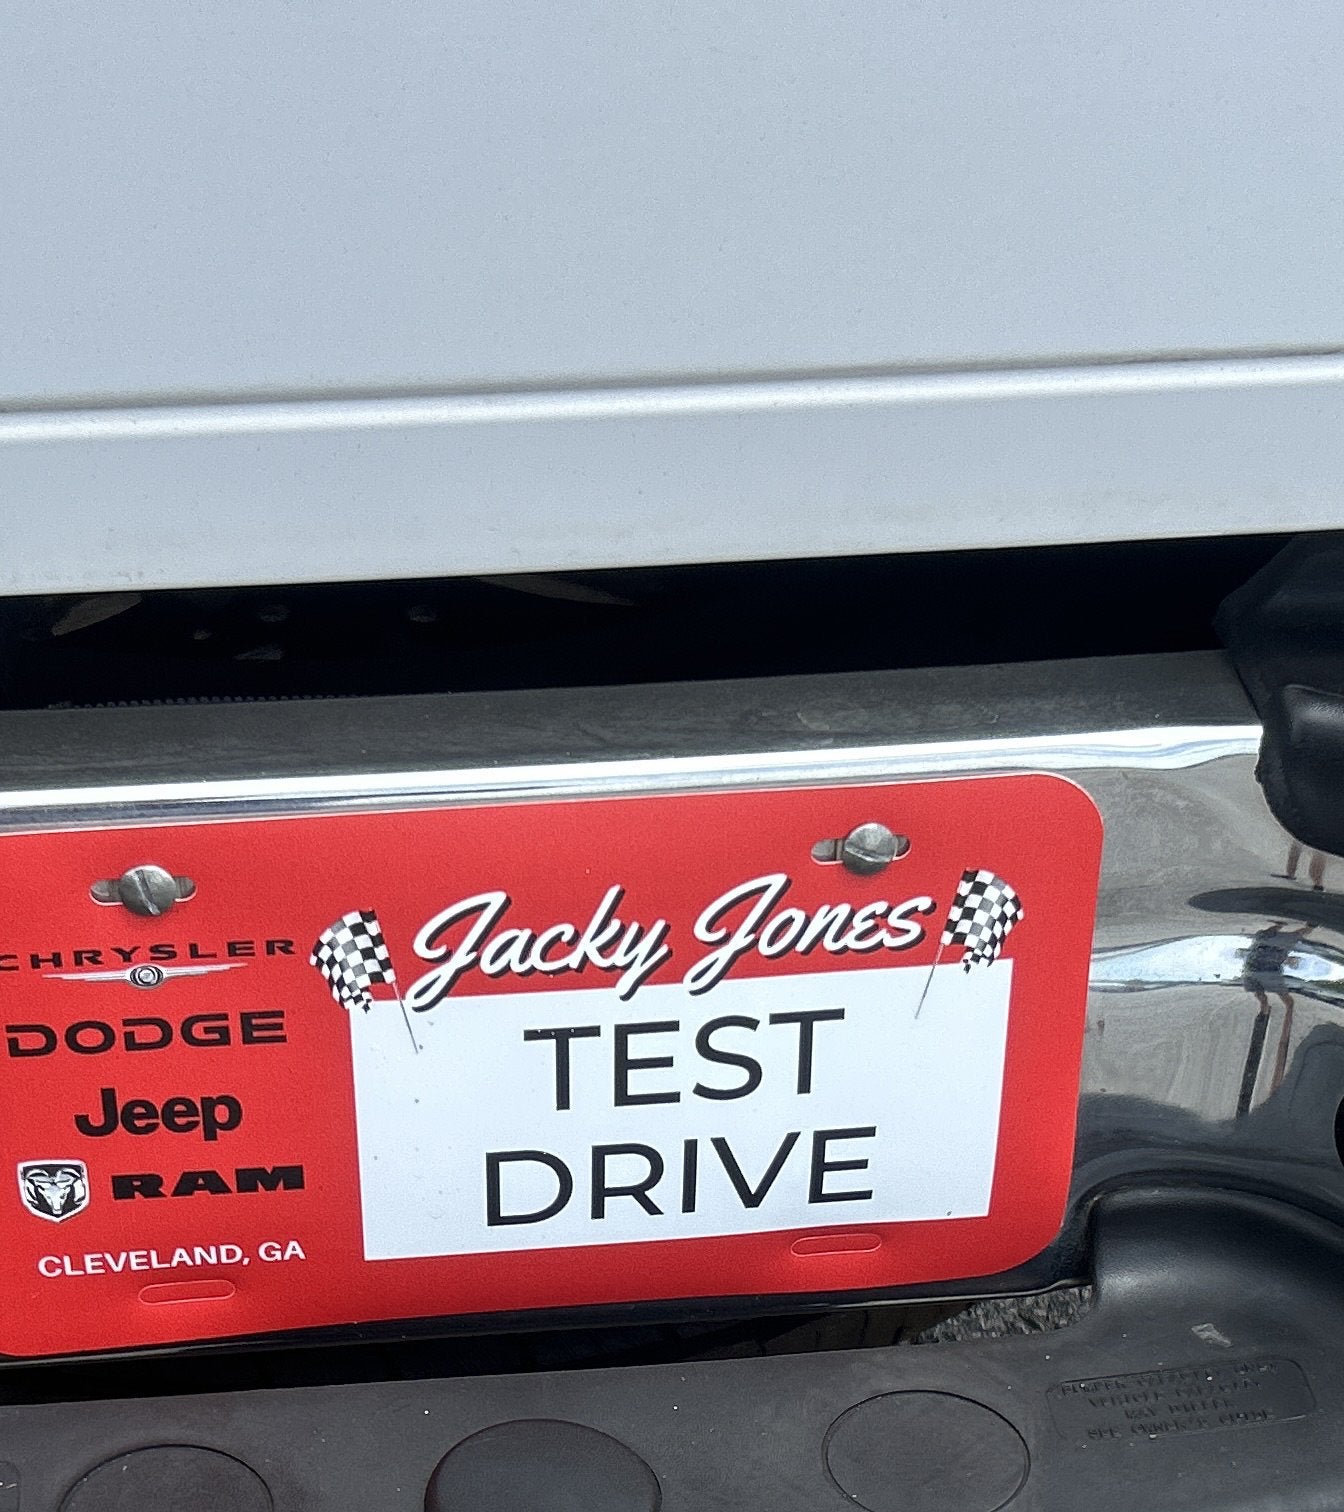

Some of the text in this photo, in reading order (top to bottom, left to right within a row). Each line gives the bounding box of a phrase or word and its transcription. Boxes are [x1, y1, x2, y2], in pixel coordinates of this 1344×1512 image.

[405, 873, 937, 1012] Jacky Jones
[5, 1010, 287, 1058] DODGE
[523, 1007, 845, 1111] TEST
[74, 1087, 243, 1141] Jeep
[111, 1164, 305, 1200] RAM
[485, 1125, 877, 1227] DRIVE
[37, 1240, 306, 1278] CLEVELAND, GA
